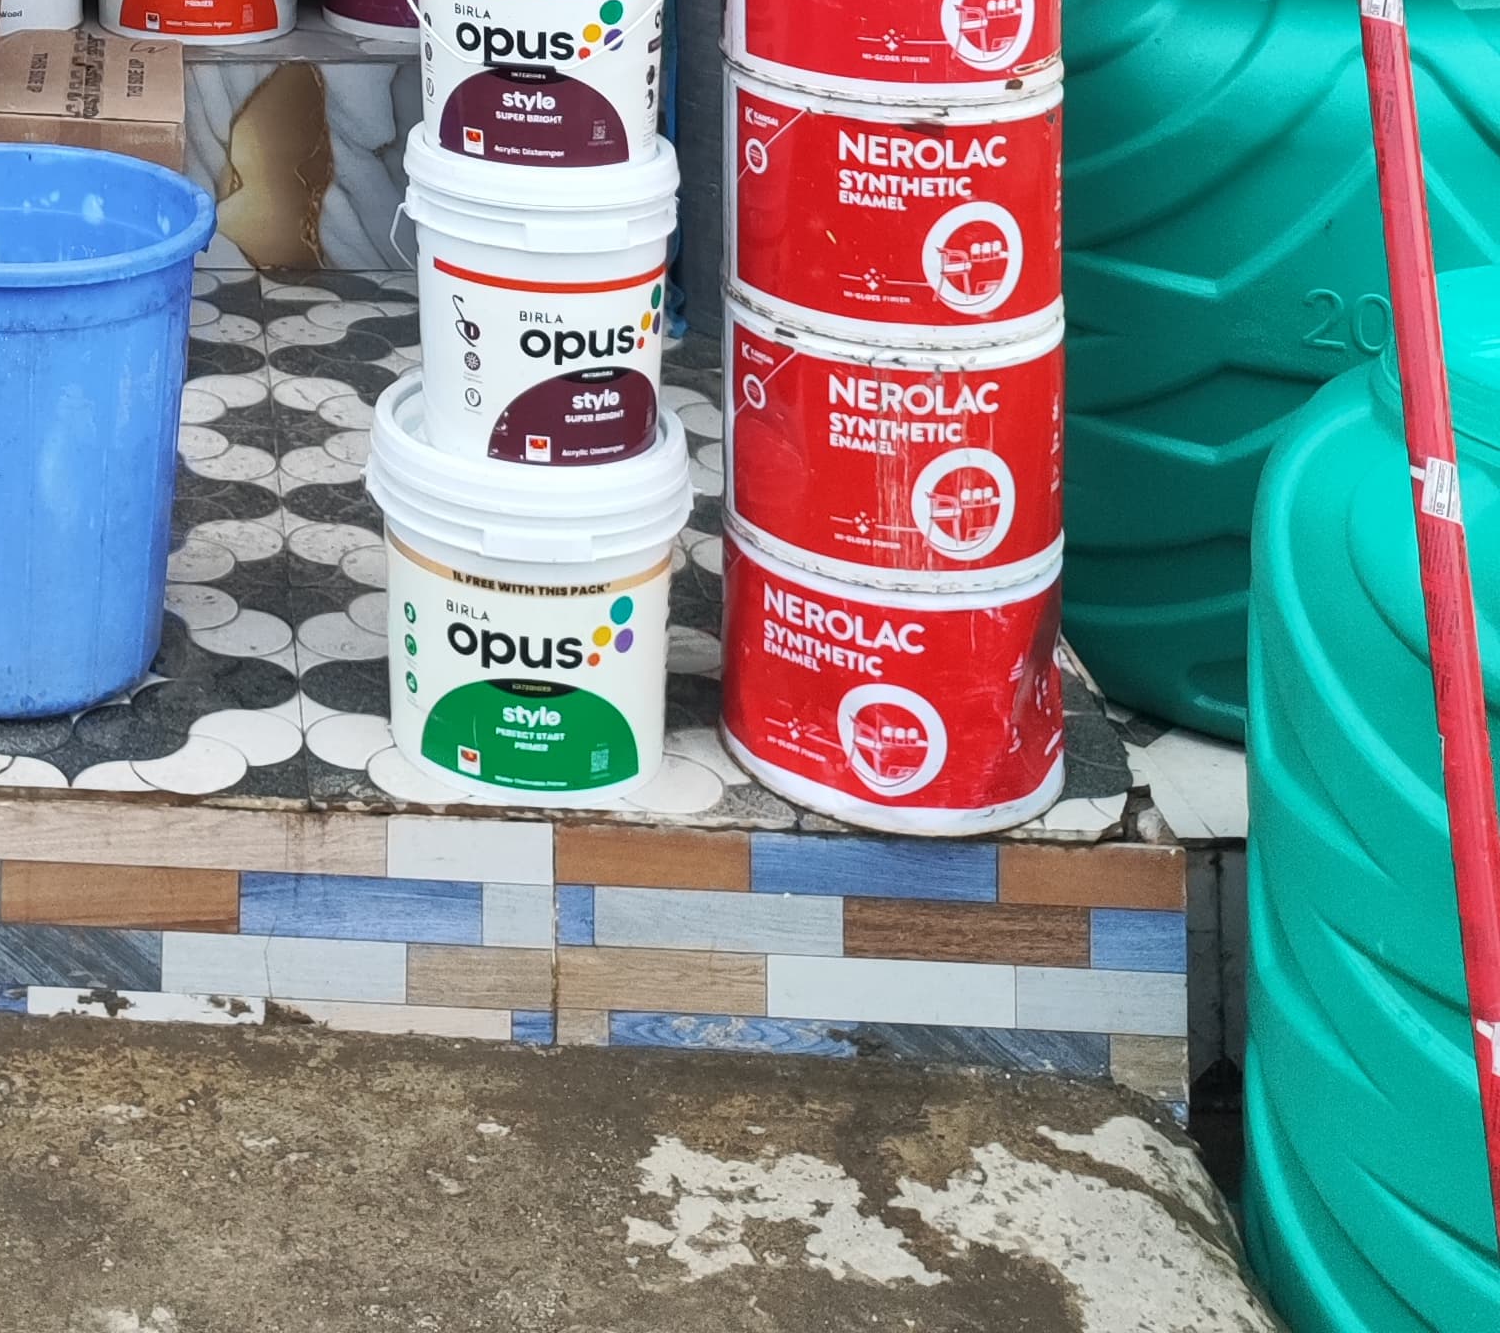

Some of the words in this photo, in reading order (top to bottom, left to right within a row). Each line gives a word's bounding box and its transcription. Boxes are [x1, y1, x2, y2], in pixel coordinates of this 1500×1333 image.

[455, 3, 491, 20] BIRLA
[456, 22, 574, 62] opus
[502, 91, 556, 110] style
[495, 111, 525, 122] SUPER
[527, 113, 562, 124] BRIGHT
[839, 130, 1007, 169] NEROLAC
[839, 169, 971, 197] SYNTHETIC
[839, 192, 906, 211] ENAMEL
[520, 311, 563, 324] BIRLA
[520, 325, 634, 365] opus
[572, 389, 620, 410] style
[829, 374, 999, 415] NEROLAC
[829, 413, 962, 442] SYNTHETIC
[829, 433, 895, 456] ENAMEL
[465, 574, 495, 590] FREE
[498, 581, 534, 595] WITH
[537, 586, 567, 596] THIS
[446, 599, 490, 622] BIRLA
[764, 582, 925, 654] NEROLAC
[447, 622, 583, 669] opus
[764, 620, 883, 677] SYNTHETIC
[764, 639, 821, 673] ENAMEL
[503, 706, 561, 727] style
[496, 728, 534, 740] PERFECT
[514, 742, 548, 752] PRIMER
